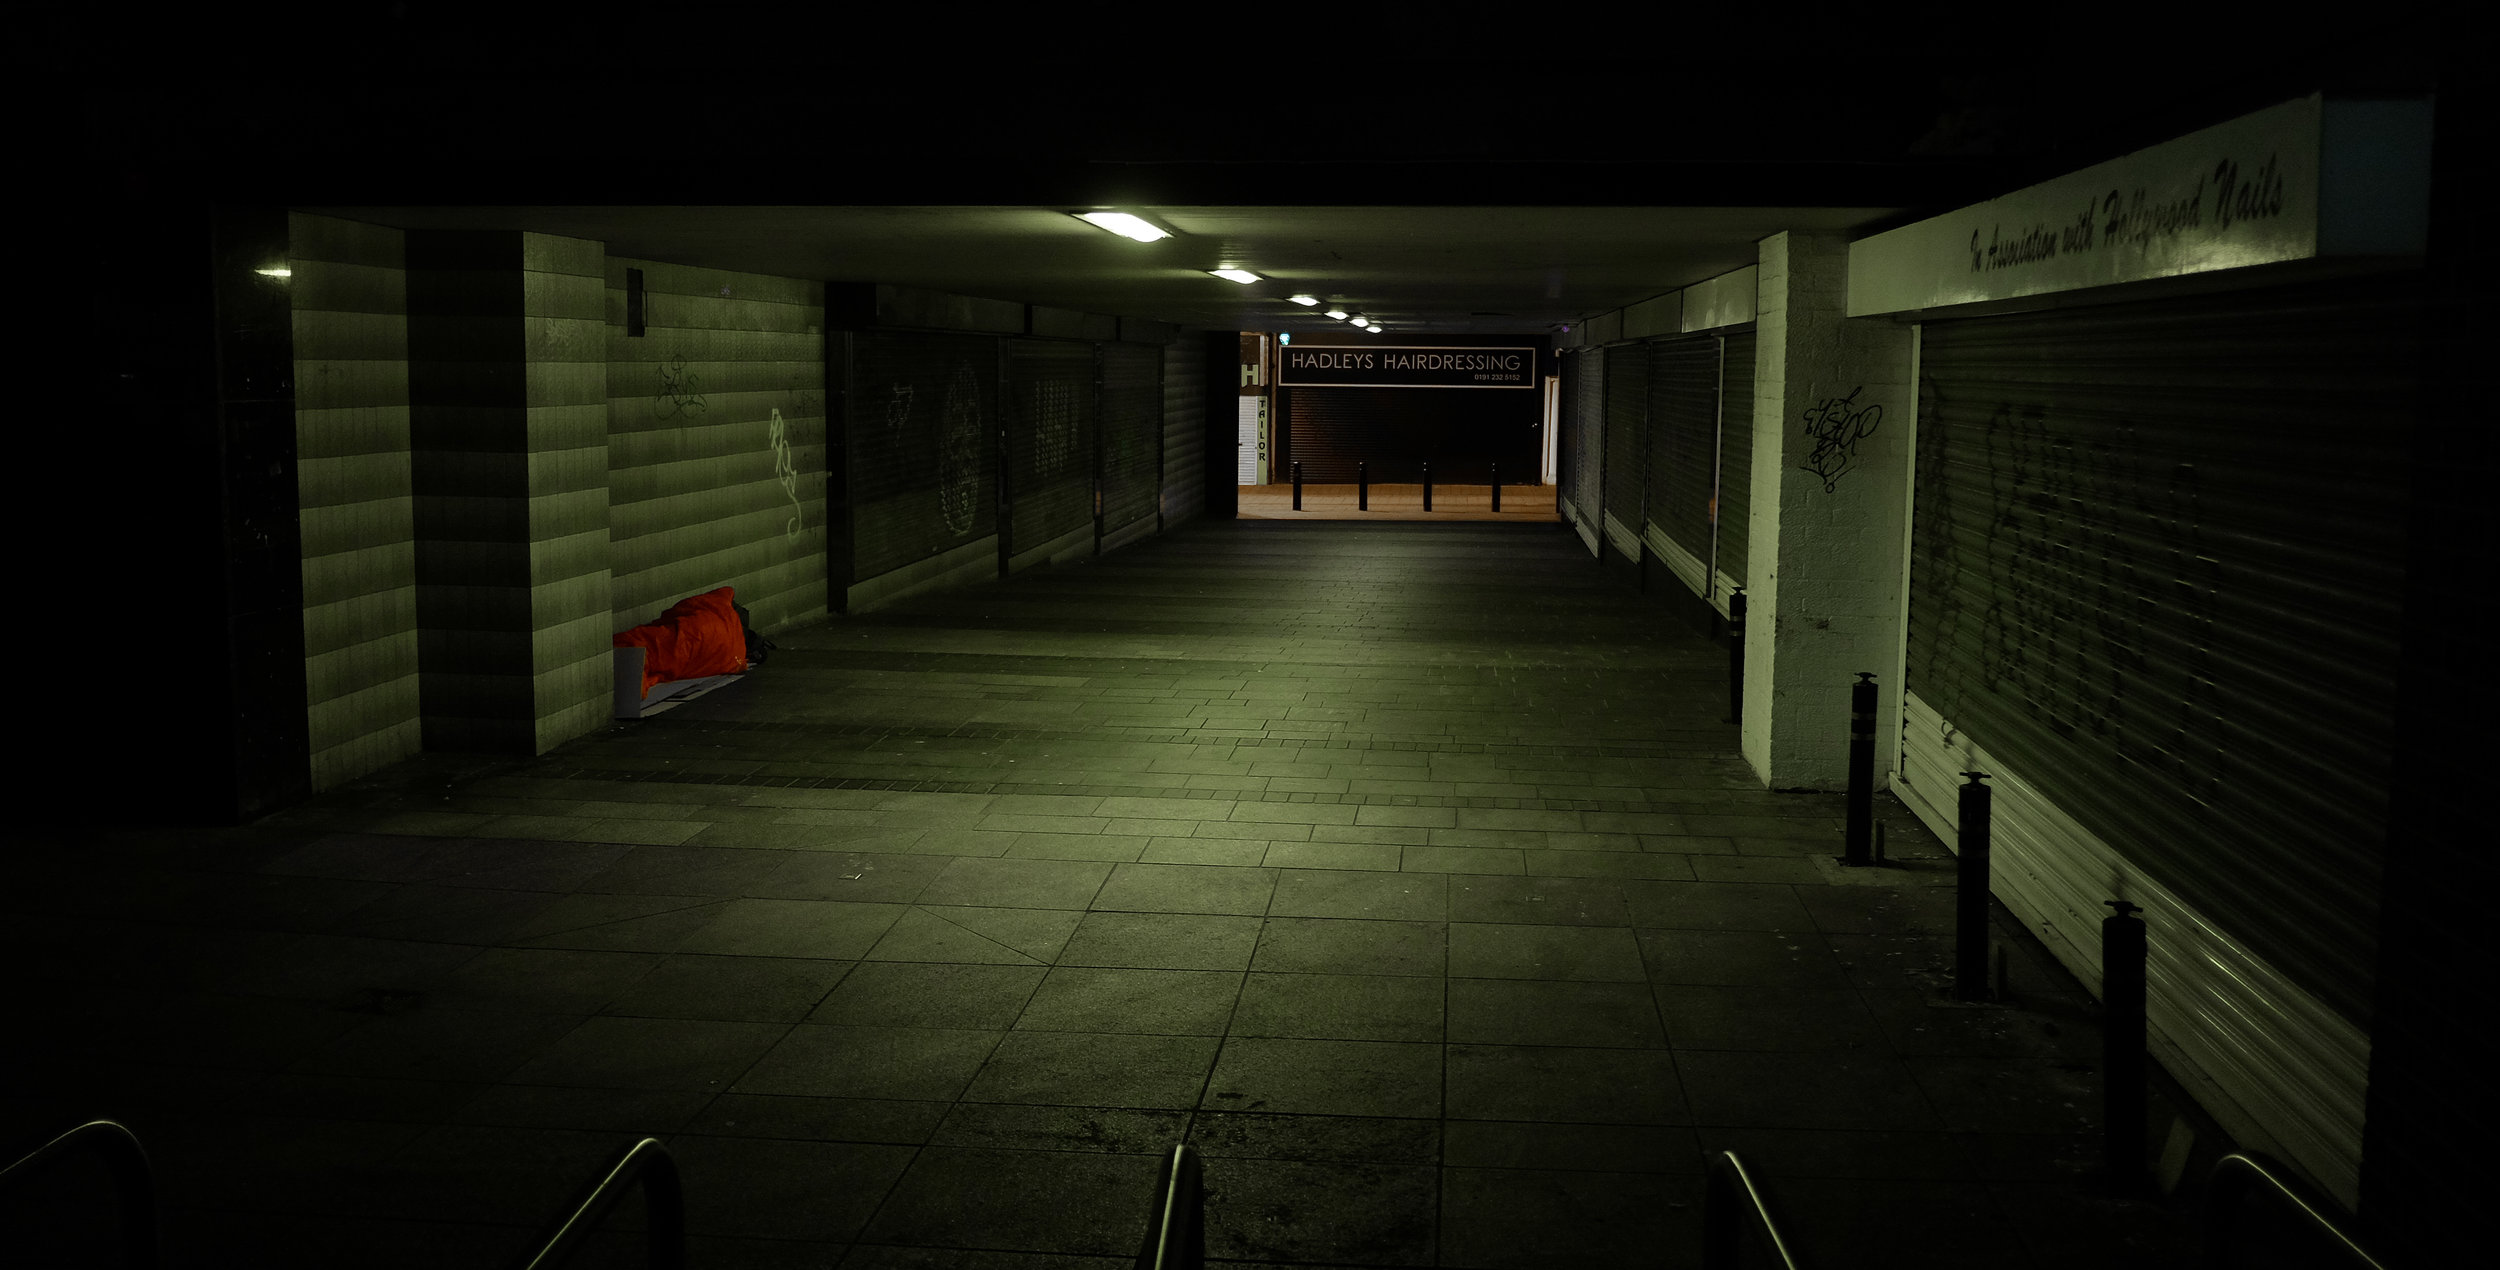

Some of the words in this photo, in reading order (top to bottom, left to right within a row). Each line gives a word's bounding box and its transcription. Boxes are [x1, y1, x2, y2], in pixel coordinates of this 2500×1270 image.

[1971, 229, 1982, 272] In
[1986, 225, 2057, 272] Association
[2062, 195, 2096, 254] with
[2103, 174, 2205, 256] Hollywood
[2214, 153, 2282, 231] Nails
[1291, 353, 1374, 369] HADLEYS
[1384, 354, 1520, 370] HAIRDRESSING
[1474, 373, 1490, 381] 0191
[1258, 400, 1266, 461] TAILOR
